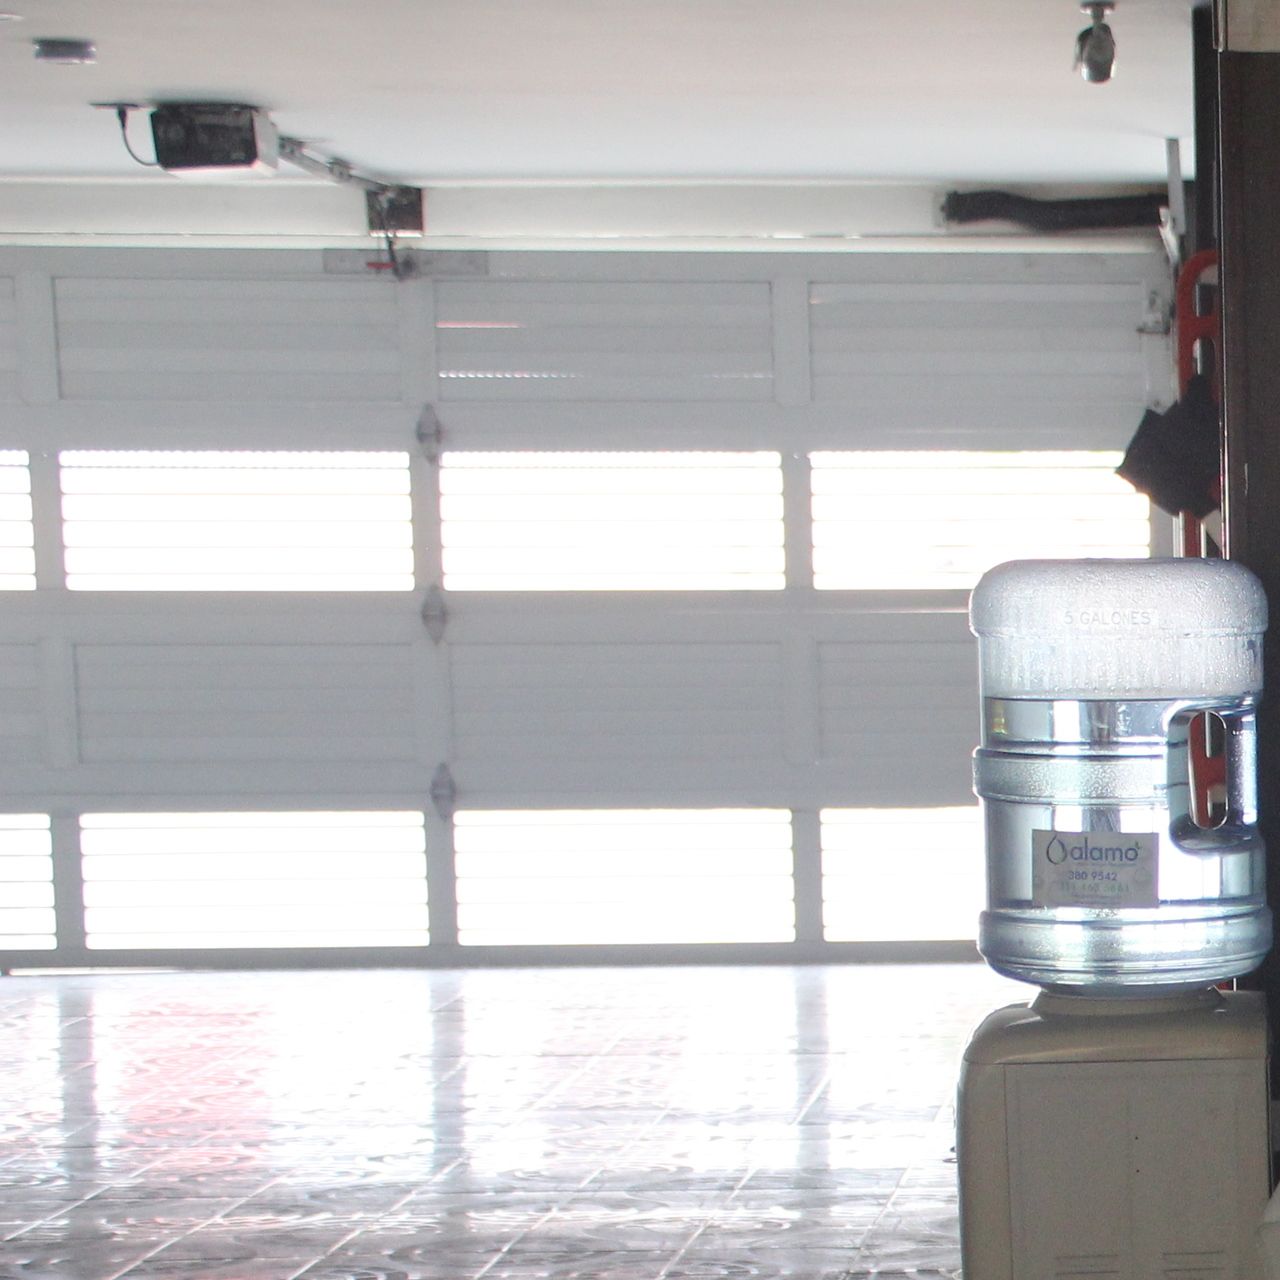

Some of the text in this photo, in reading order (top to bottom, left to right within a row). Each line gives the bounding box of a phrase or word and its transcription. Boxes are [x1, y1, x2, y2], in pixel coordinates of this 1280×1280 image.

[1063, 610, 1152, 625] 5 GALONES
[1070, 836, 1139, 862] alamo
[1090, 871, 1118, 882] 9542
